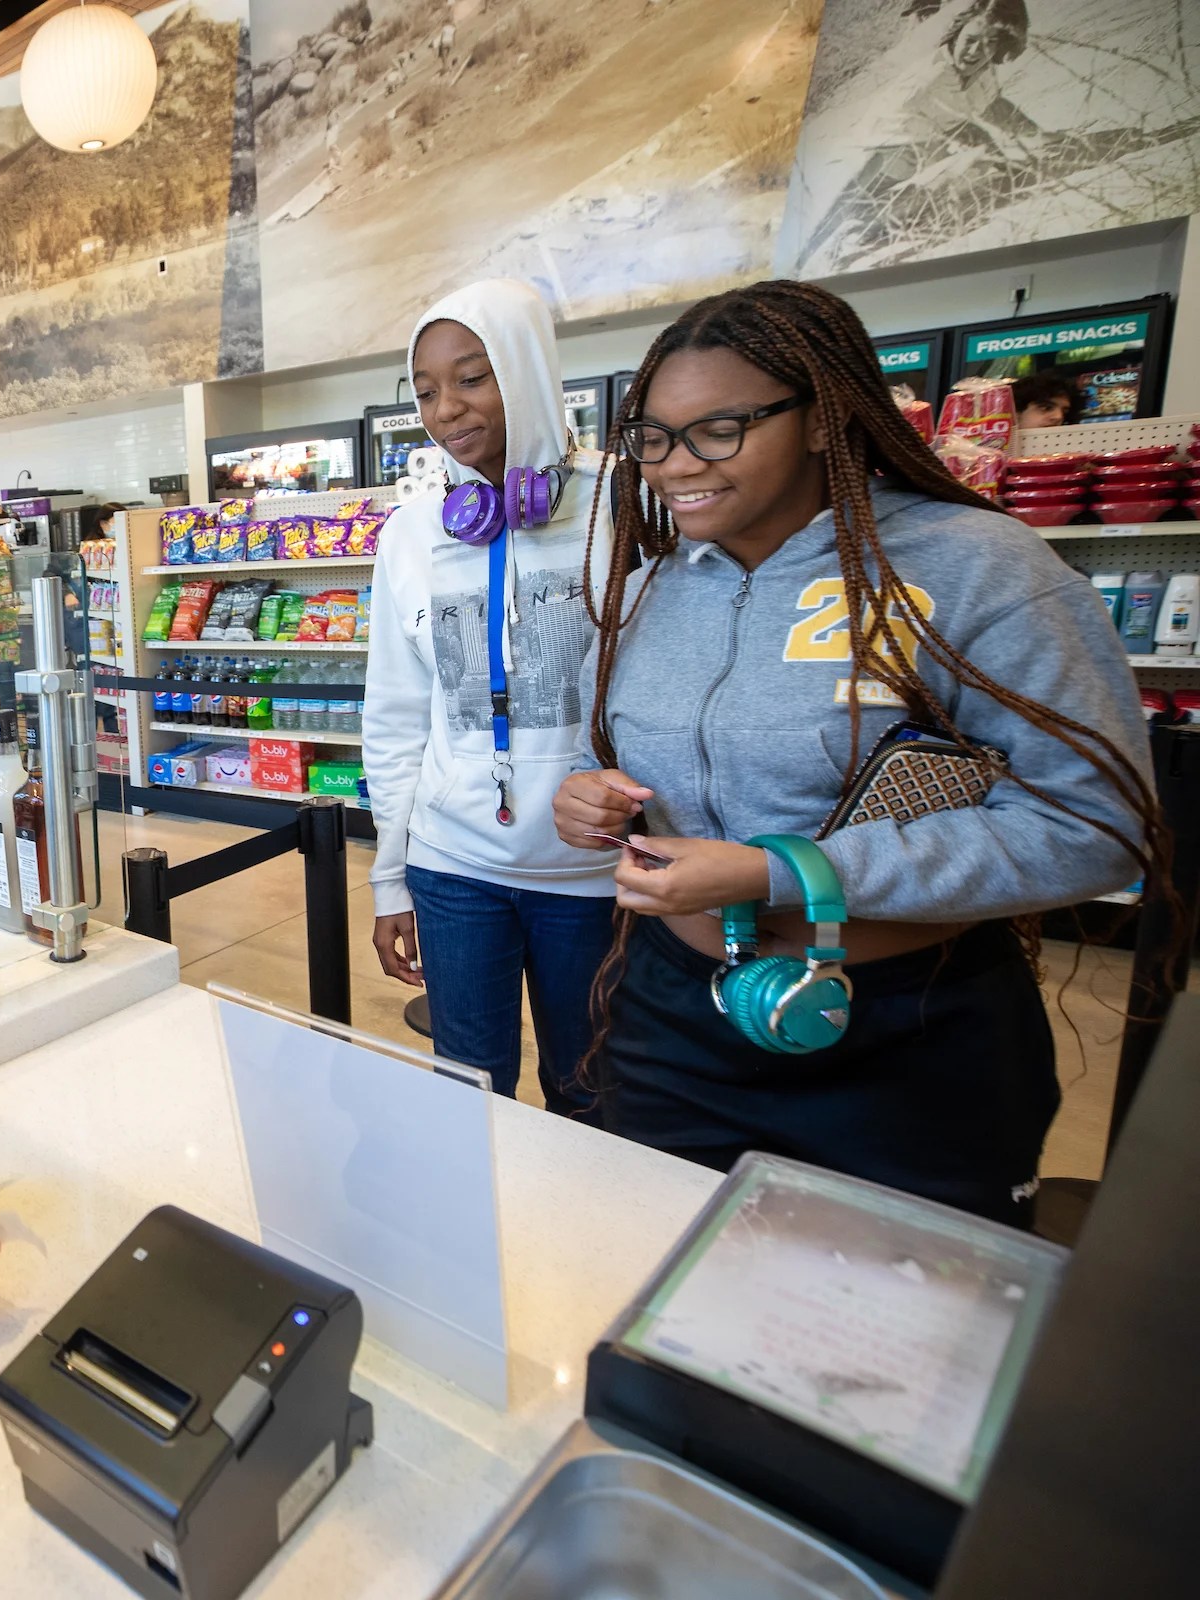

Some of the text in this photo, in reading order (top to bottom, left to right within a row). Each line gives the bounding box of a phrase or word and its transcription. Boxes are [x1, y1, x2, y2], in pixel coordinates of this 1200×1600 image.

[976, 321, 1138, 354] FROZEN SNACKS
[878, 350, 921, 366] ACKS
[1092, 370, 1139, 385] Celeste
[382, 417, 412, 428] COOL
[953, 421, 1009, 436] SOLO
[783, 577, 936, 679] 26
